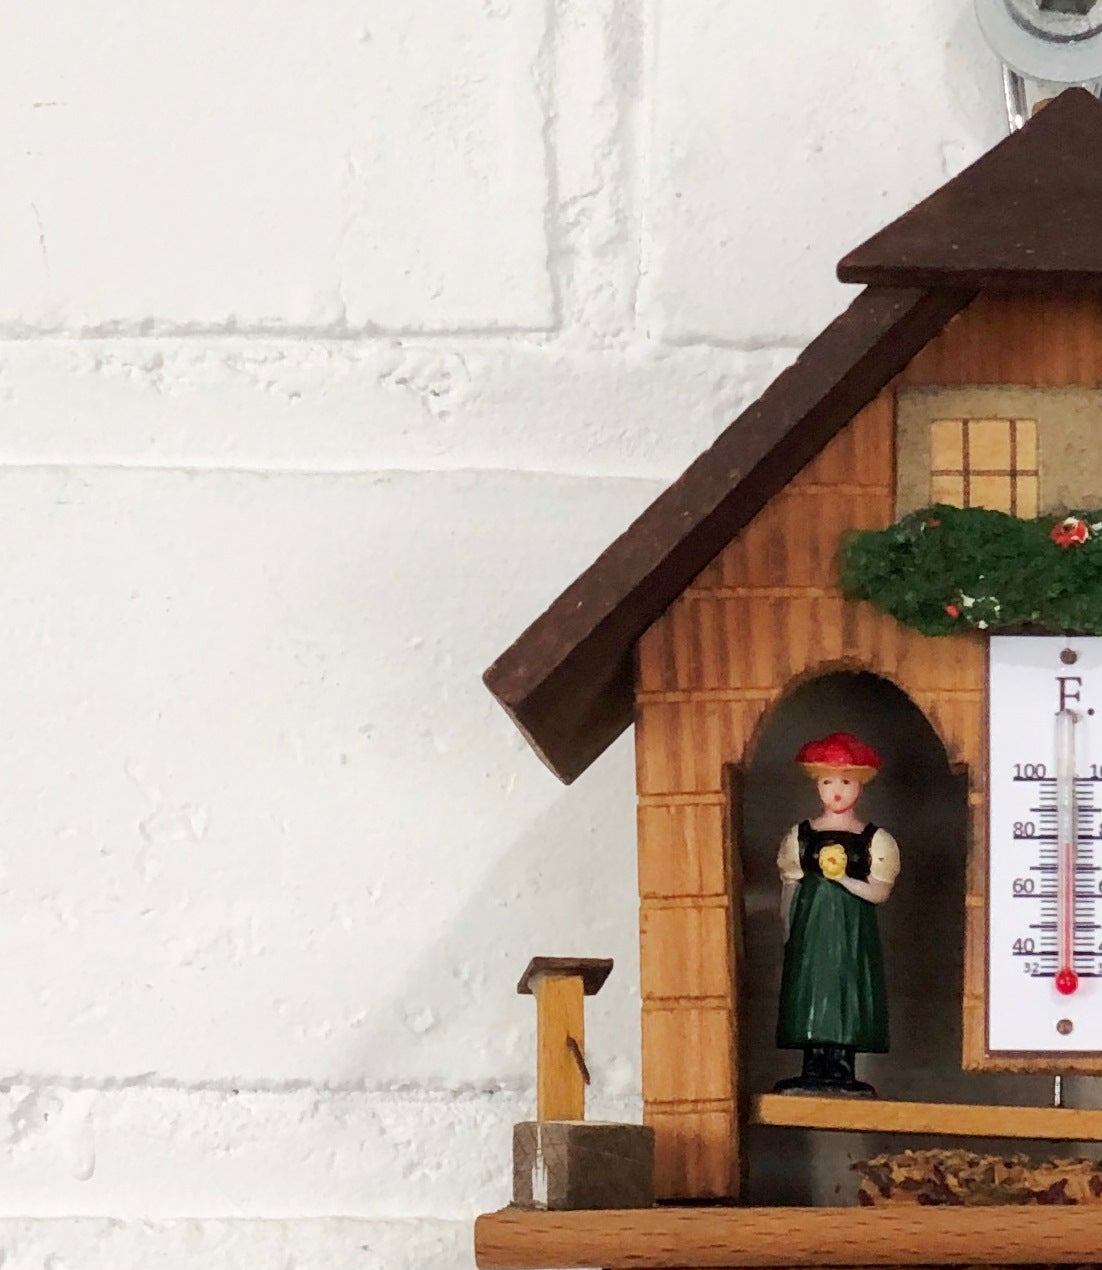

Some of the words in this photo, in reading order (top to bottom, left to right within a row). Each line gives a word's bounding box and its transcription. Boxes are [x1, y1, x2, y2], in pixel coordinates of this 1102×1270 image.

[1013, 764, 1046, 779] 100
[1013, 822, 1035, 837] 80
[1013, 878, 1034, 893] 60
[1013, 938, 1034, 952] 40
[1024, 962, 1040, 974] 32
